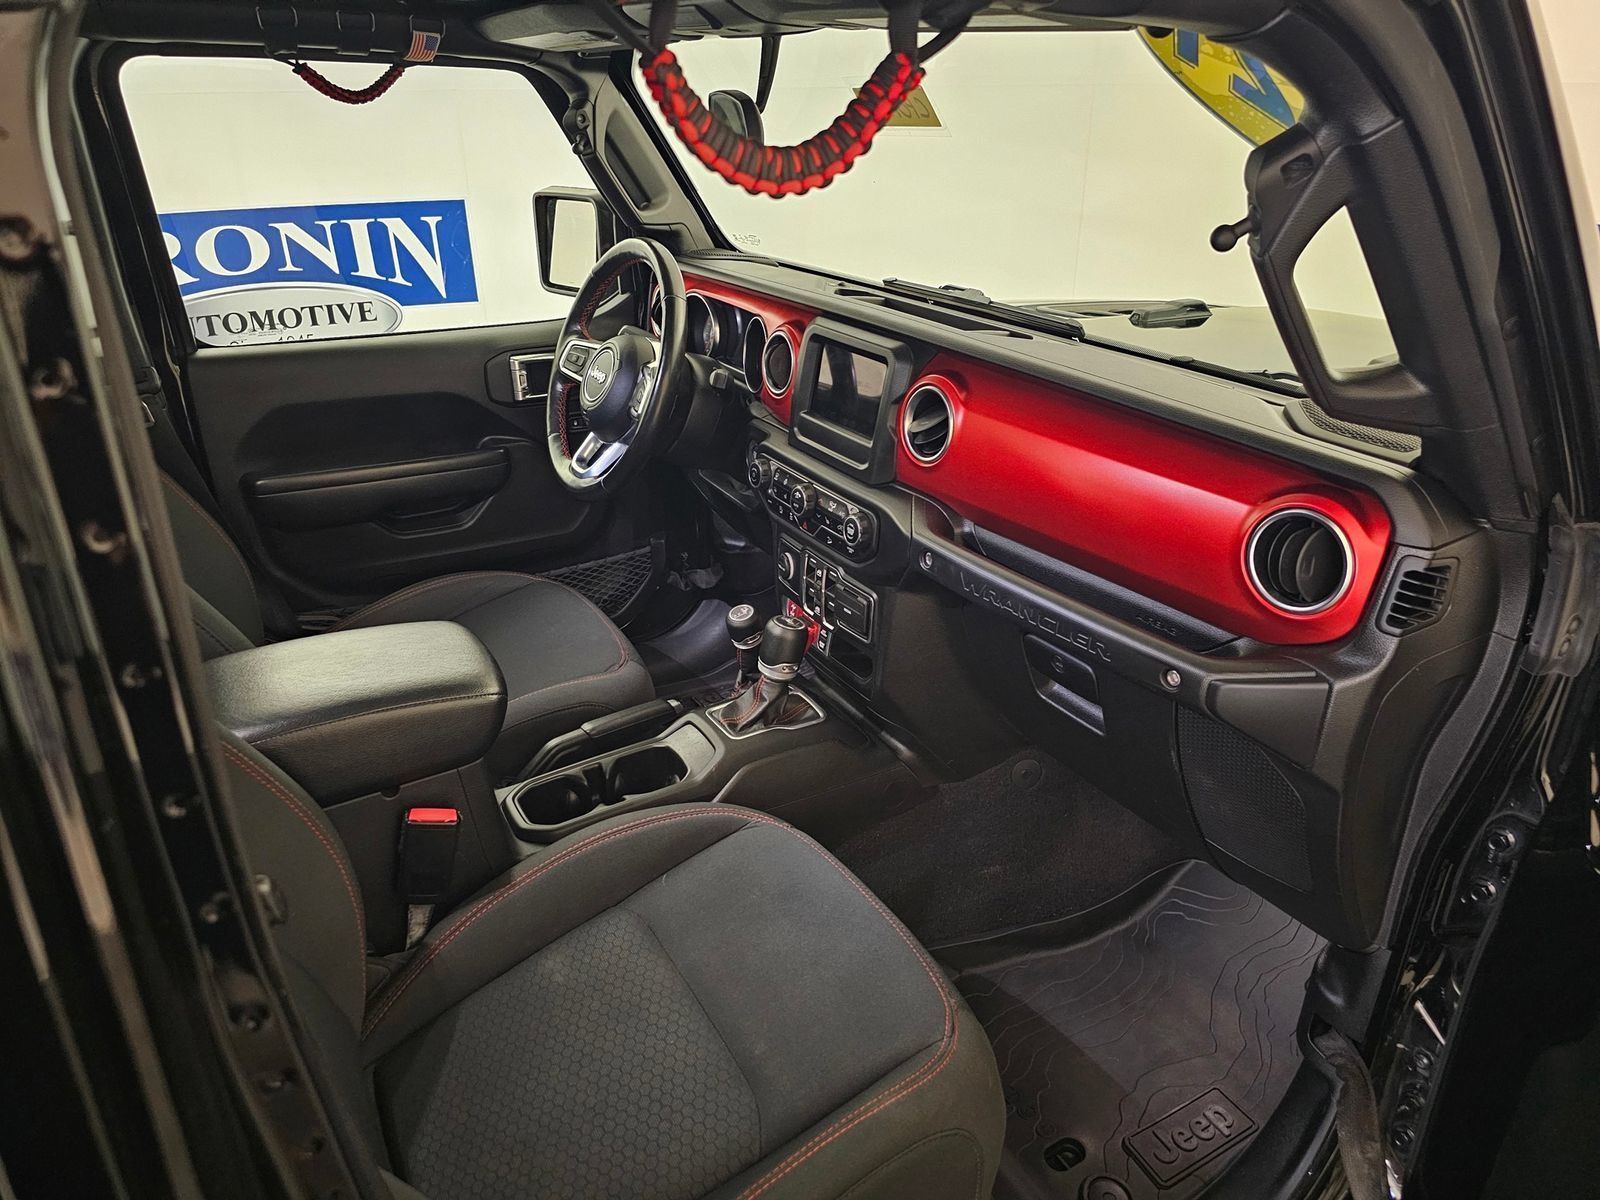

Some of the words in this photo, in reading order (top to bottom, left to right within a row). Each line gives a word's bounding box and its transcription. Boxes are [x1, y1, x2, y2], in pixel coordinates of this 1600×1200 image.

[590, 365, 606, 384] Jeep
[960, 571, 1112, 662] WRANGLER
[1152, 1104, 1235, 1164] Jeep
